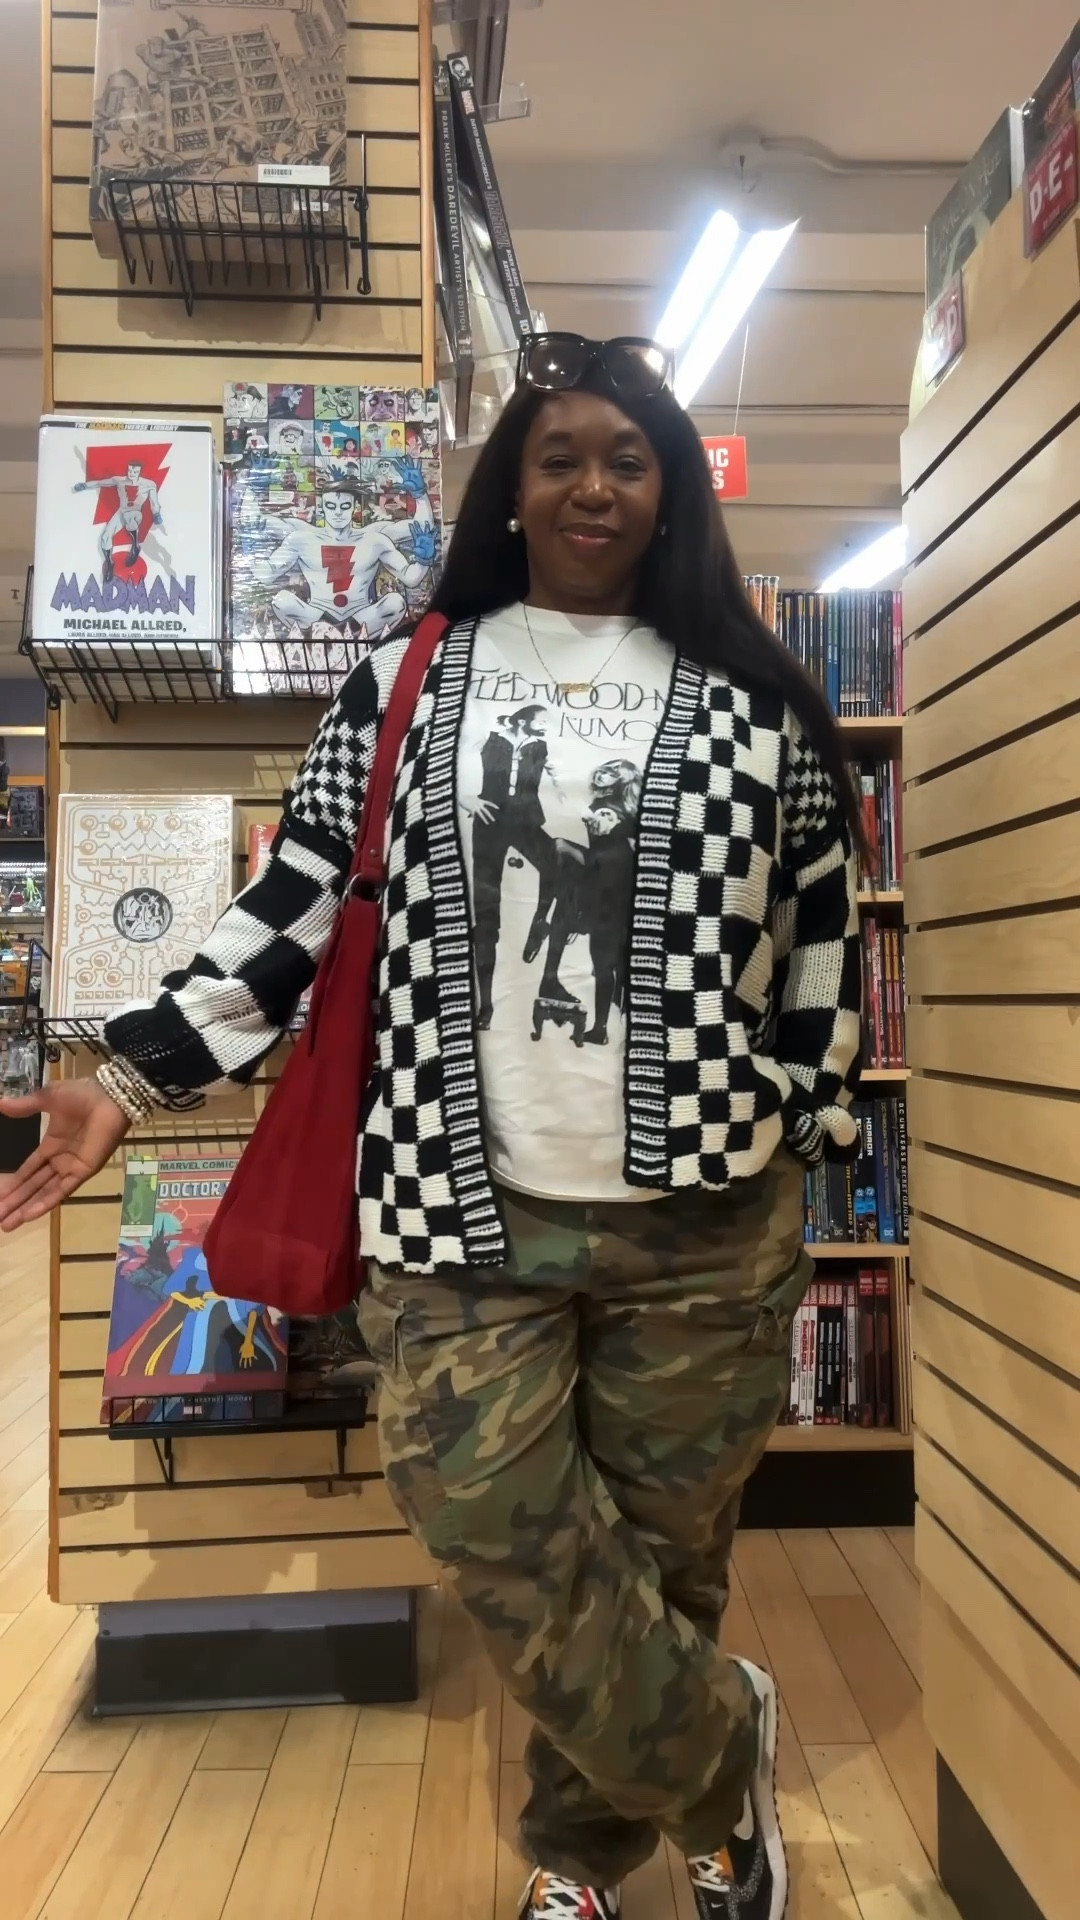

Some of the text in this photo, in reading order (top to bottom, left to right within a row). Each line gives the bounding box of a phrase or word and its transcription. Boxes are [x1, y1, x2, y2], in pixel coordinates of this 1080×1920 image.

[461, 89, 475, 115] MARVEL
[441, 110, 450, 139] FRANK
[443, 142, 453, 182] MILLER'S
[447, 185, 459, 250] DAREDEVIL
[484, 190, 511, 250] DAREDEVIL
[452, 253, 462, 292] ARTIST'S
[456, 294, 466, 332] EDITION
[519, 318, 532, 336] ID
[50, 572, 196, 616] MADMAN
[64, 619, 187, 633] MICHAEL ALLRED,
[865, 1117, 873, 1156] HORROR
[899, 1117, 907, 1163] UNIVERSE
[160, 1162, 200, 1171] MARVEL
[159, 1181, 220, 1197] DOCTOR
